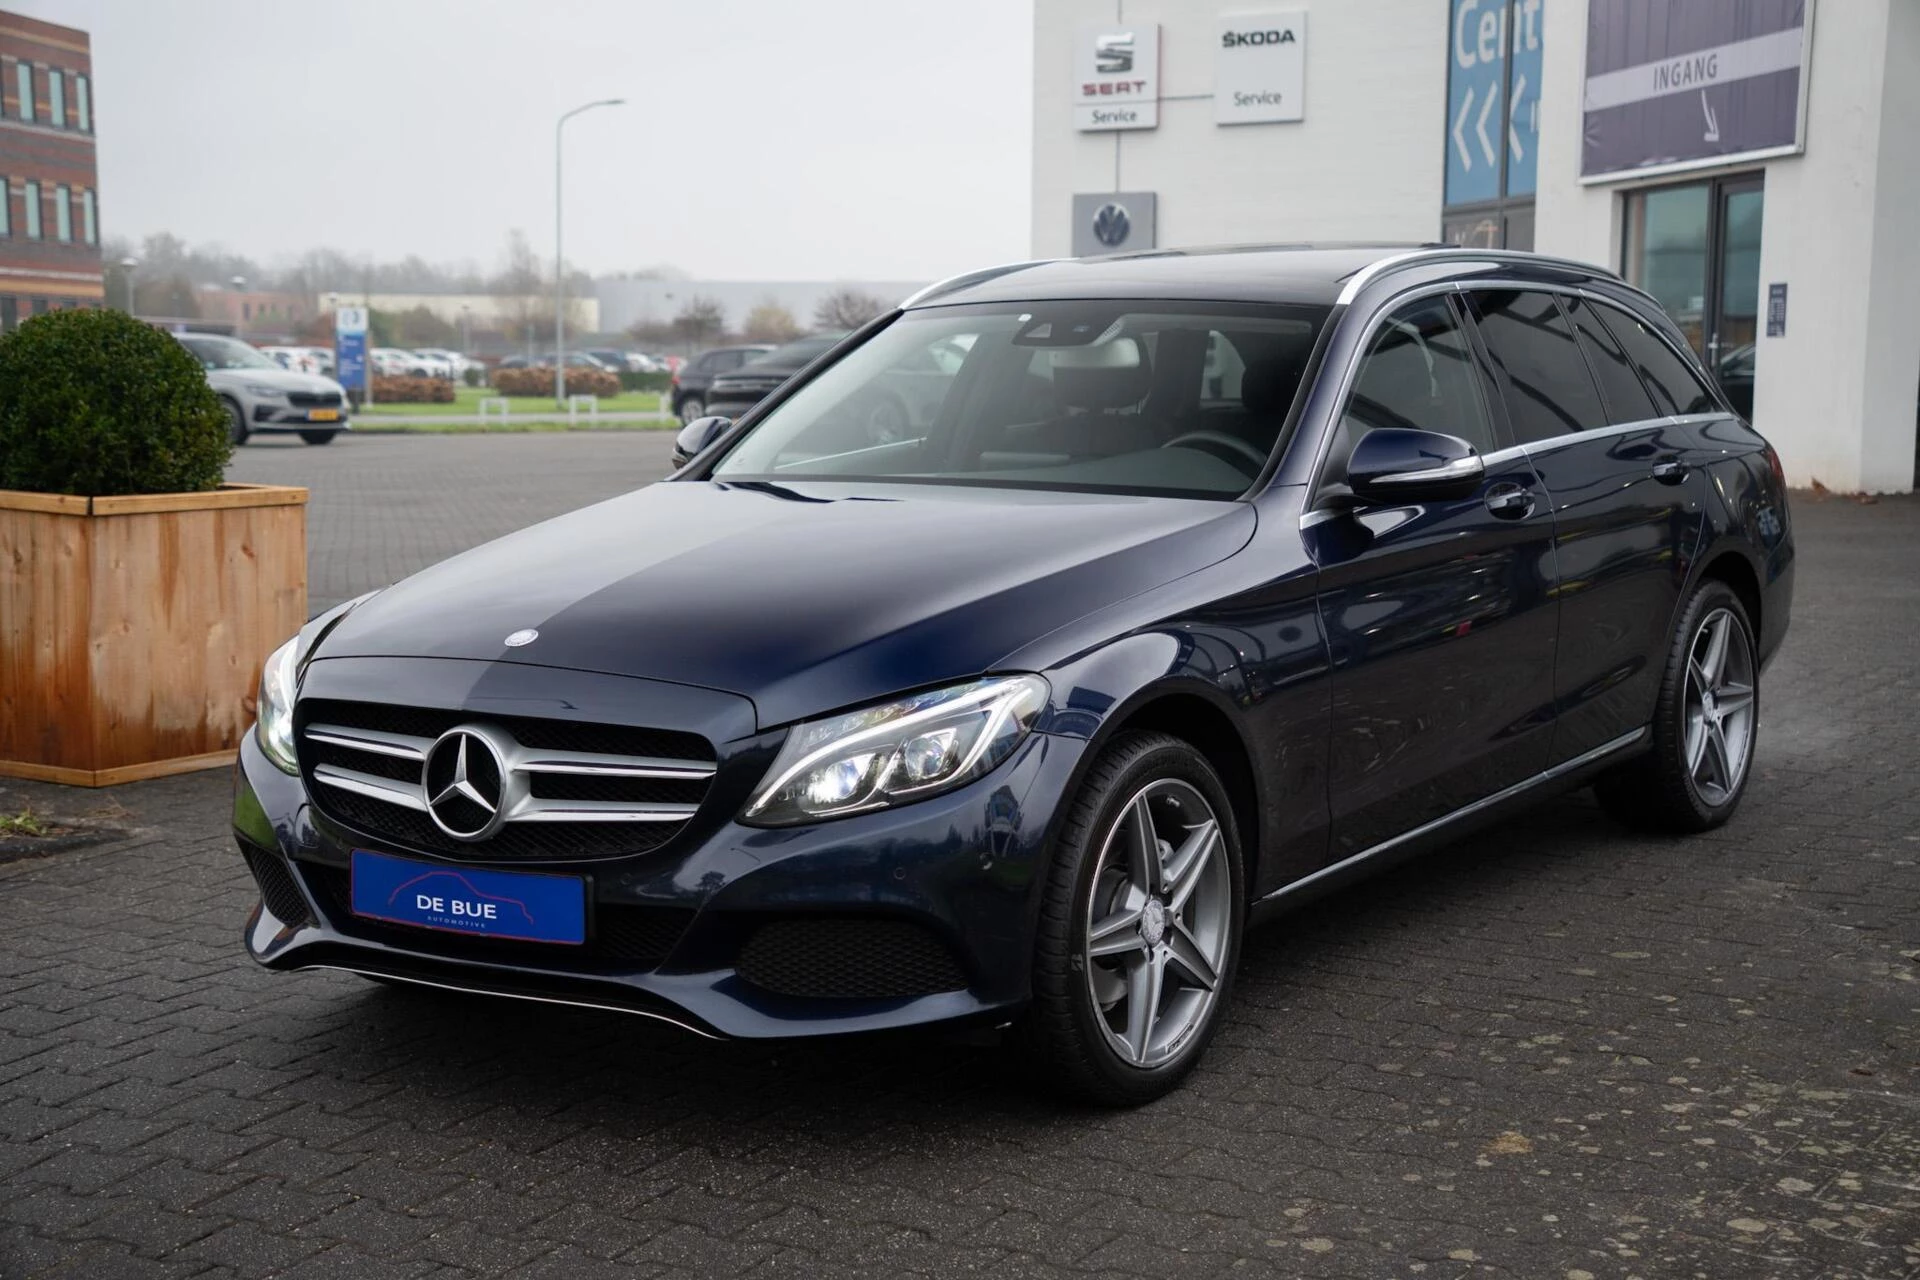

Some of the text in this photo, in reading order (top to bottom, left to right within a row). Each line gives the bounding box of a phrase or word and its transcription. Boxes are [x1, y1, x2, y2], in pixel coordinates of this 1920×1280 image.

[1653, 53, 1718, 91] INGANG
[1082, 80, 1147, 96] SEAT
[1234, 90, 1282, 106] Service
[1092, 108, 1137, 124] Service
[416, 894, 497, 919] DE BUE
[427, 915, 486, 929] AUTOMOTIVE
